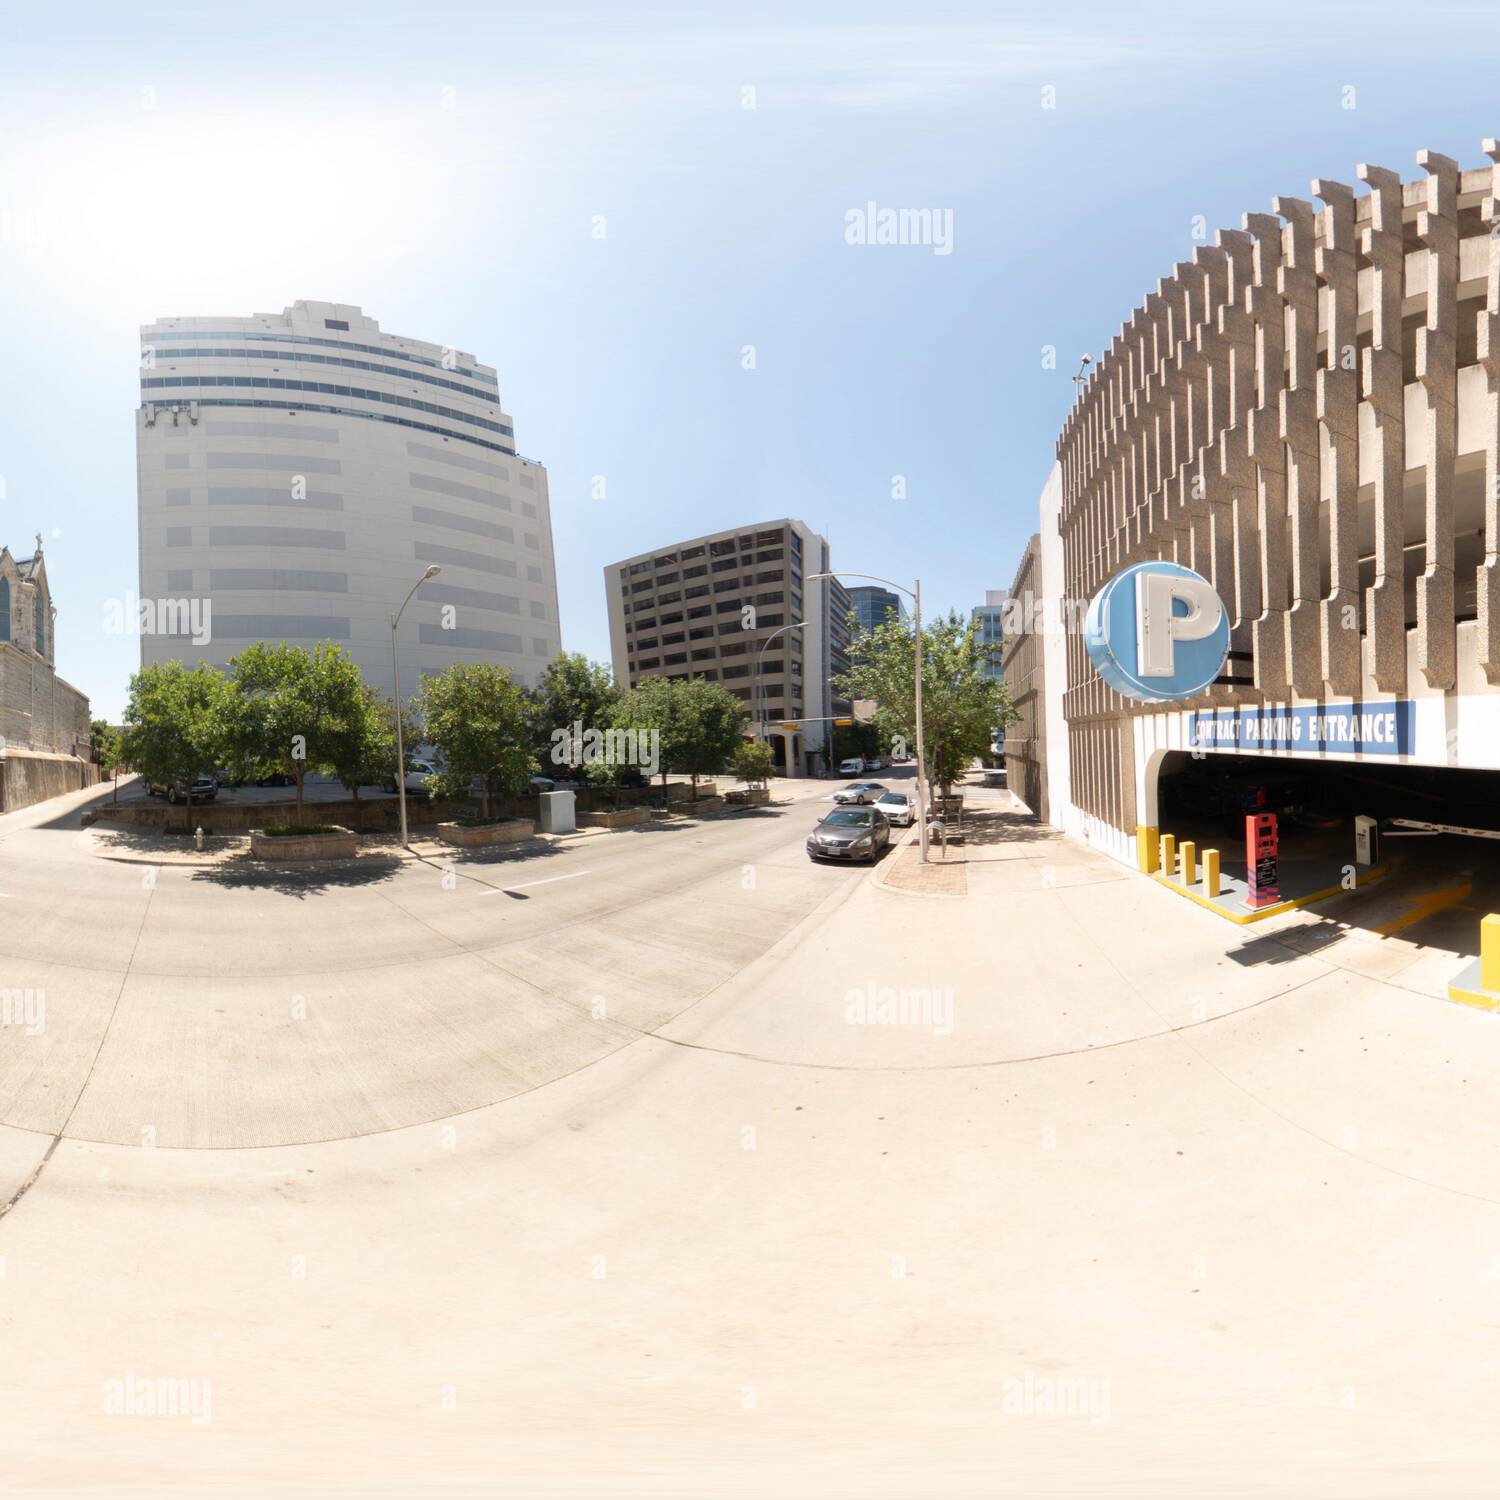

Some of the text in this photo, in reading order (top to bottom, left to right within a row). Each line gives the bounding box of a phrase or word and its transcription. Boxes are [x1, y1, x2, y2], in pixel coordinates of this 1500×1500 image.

[1136, 572, 1222, 677] P
[1196, 713, 1395, 743] CONTRACT PARKING ENTRANCE
